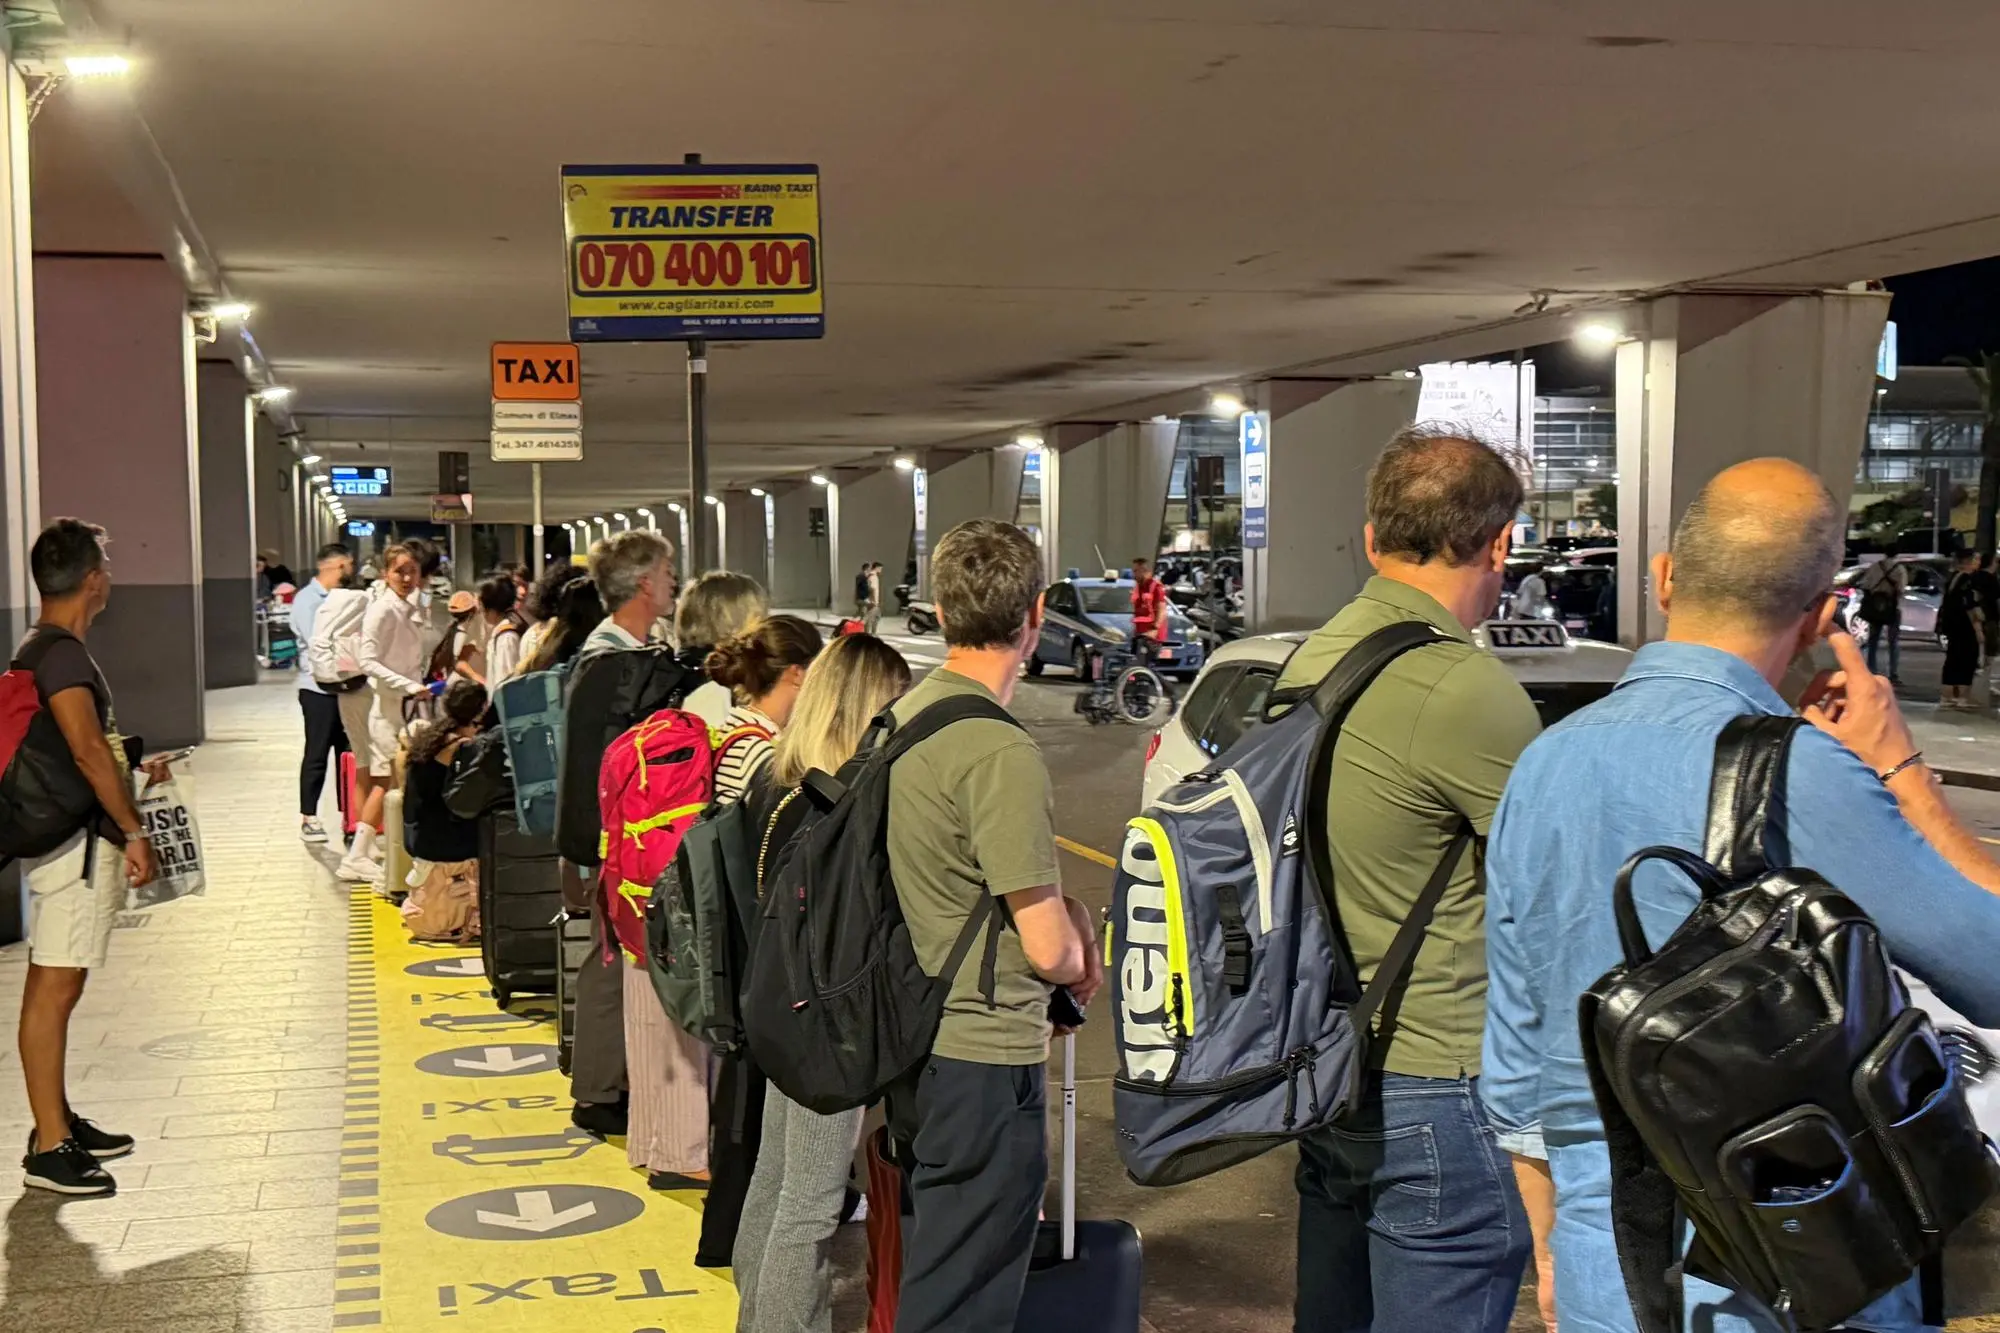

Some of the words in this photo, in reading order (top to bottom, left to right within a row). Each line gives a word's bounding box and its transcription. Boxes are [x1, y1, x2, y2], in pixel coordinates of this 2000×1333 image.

[786, 184, 813, 192] TAXI
[610, 205, 774, 228] TRANSFER
[579, 242, 655, 288] 070
[664, 242, 743, 287] 400
[749, 241, 809, 285] 101
[618, 299, 774, 311] www.cagliaritaxi.com
[497, 359, 574, 384] TAXI
[1488, 626, 1561, 645] TAXI
[422, 1095, 574, 1120] axi
[438, 1269, 699, 1316] Taxi
